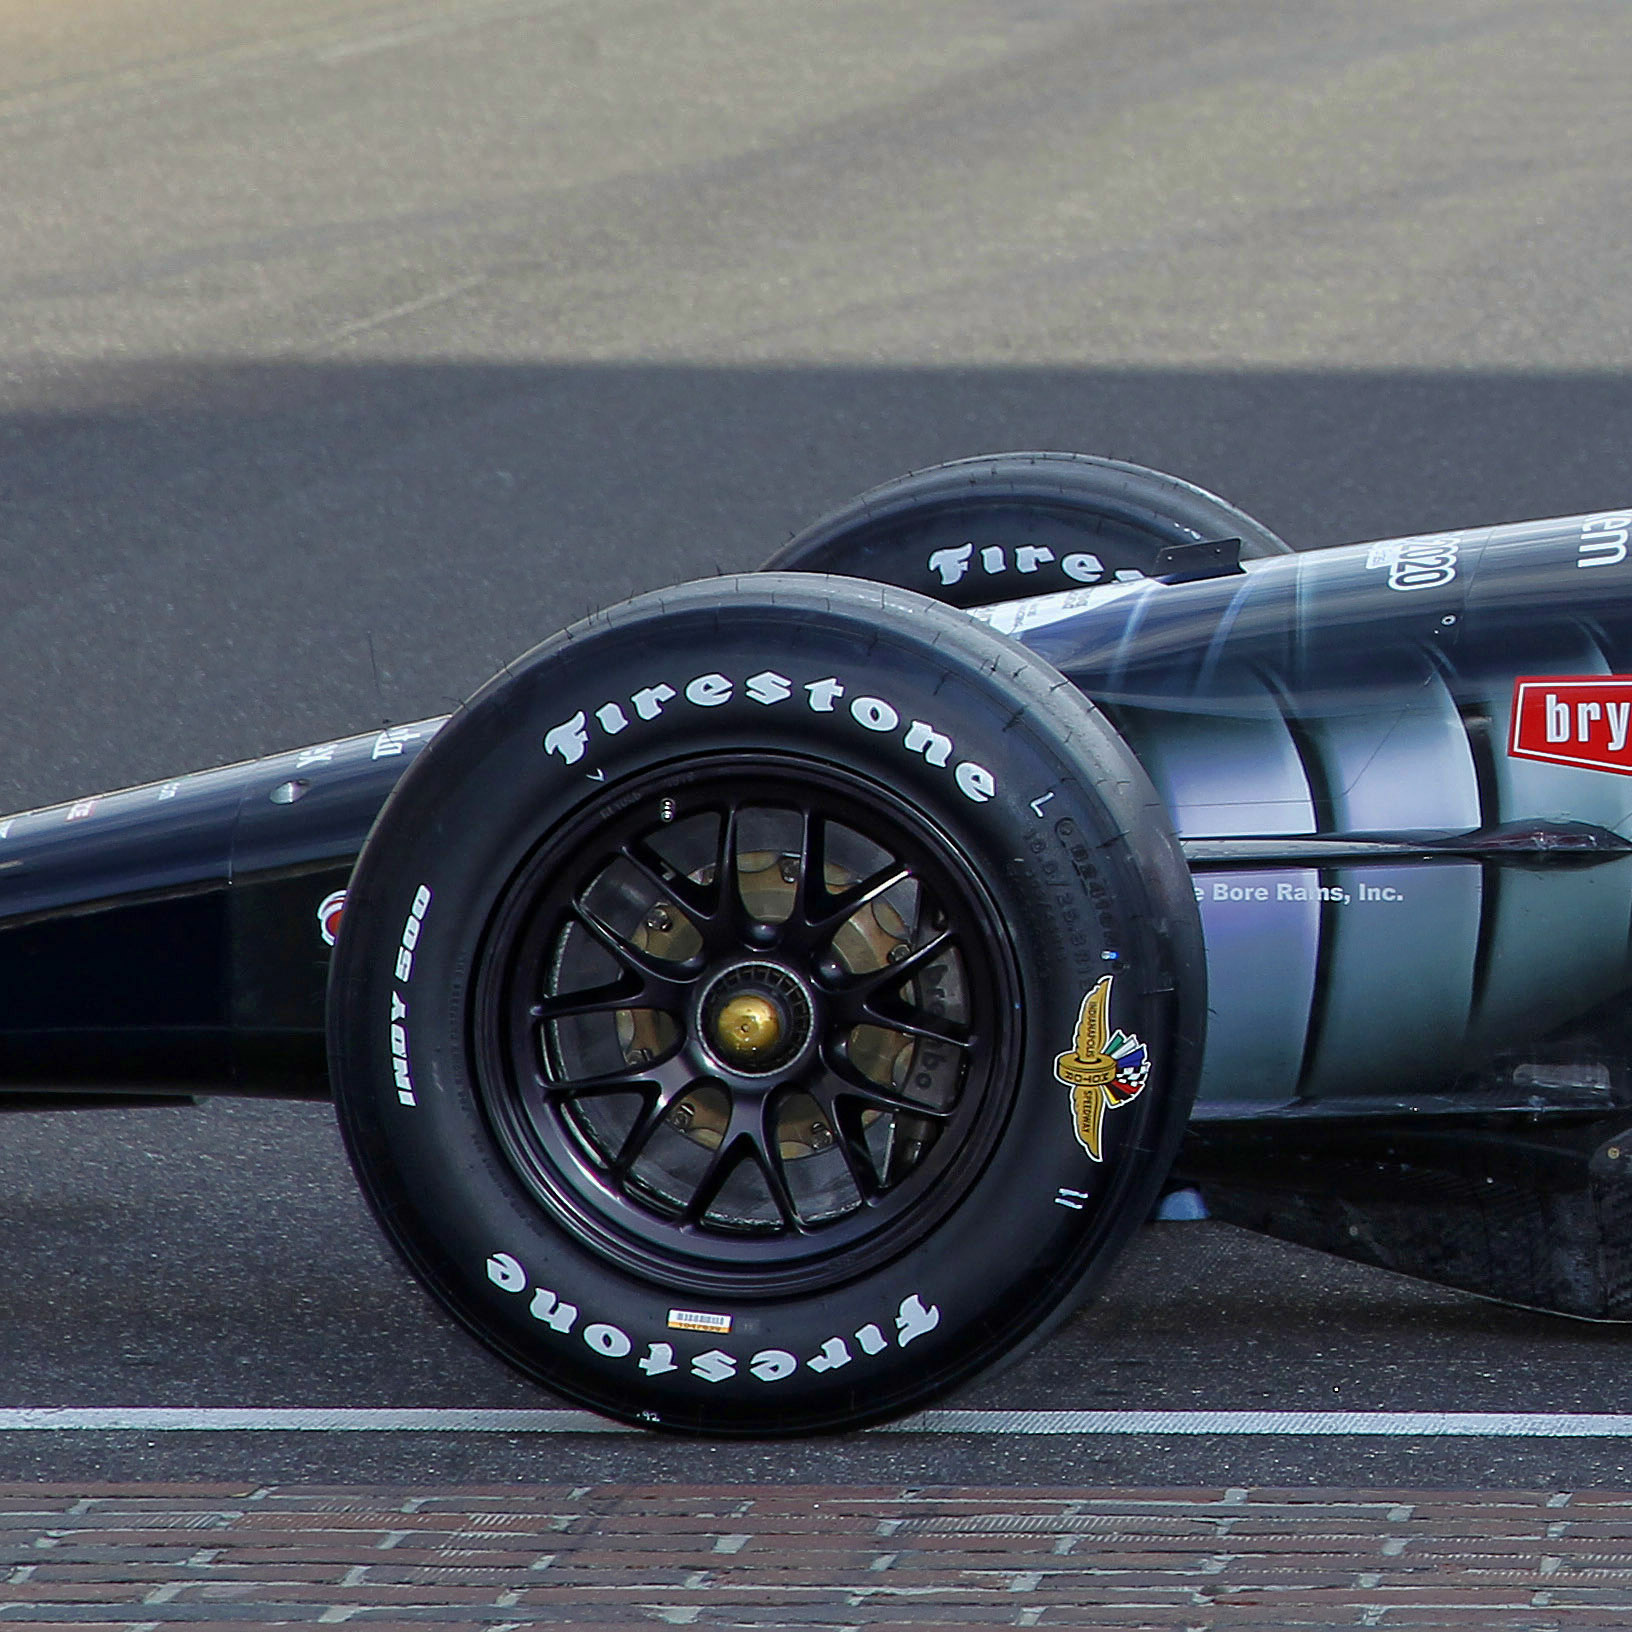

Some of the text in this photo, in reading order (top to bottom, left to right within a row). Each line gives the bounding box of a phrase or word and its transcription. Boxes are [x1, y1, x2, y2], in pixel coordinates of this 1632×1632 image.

[544, 671, 997, 803] Firestone
[1213, 883, 1269, 902] Bore
[1276, 883, 1351, 905] Rams,
[1359, 883, 1404, 902] Inc.
[390, 884, 432, 1107] INDY 500
[1087, 1001, 1097, 1058] INDIANAPOLIS
[1064, 1071, 1110, 1083] MOTOR
[1081, 1090, 1091, 1134] SPEEDWAY
[487, 1253, 940, 1382] Firestone
